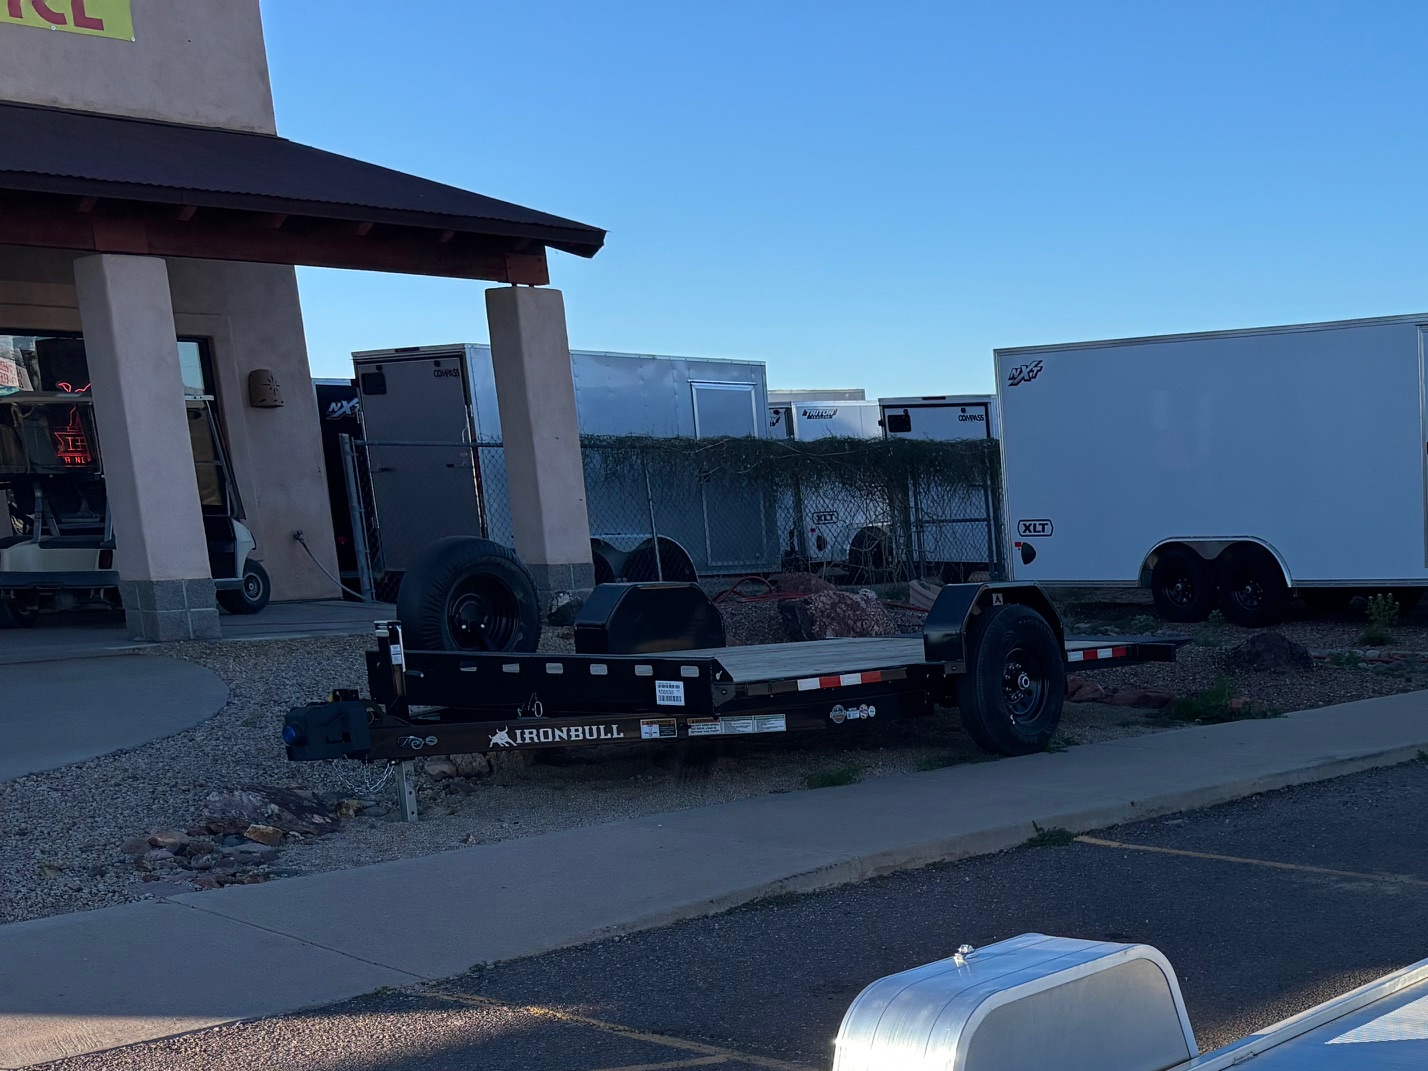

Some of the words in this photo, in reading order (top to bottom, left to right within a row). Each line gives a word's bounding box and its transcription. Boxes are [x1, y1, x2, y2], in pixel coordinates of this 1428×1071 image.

[434, 368, 460, 378] COMPASS
[1008, 360, 1043, 387] NXT
[806, 408, 836, 416] TRITON
[958, 414, 985, 422] COMPASS
[1022, 522, 1049, 534] XLT
[515, 724, 624, 744] IRONBULL
